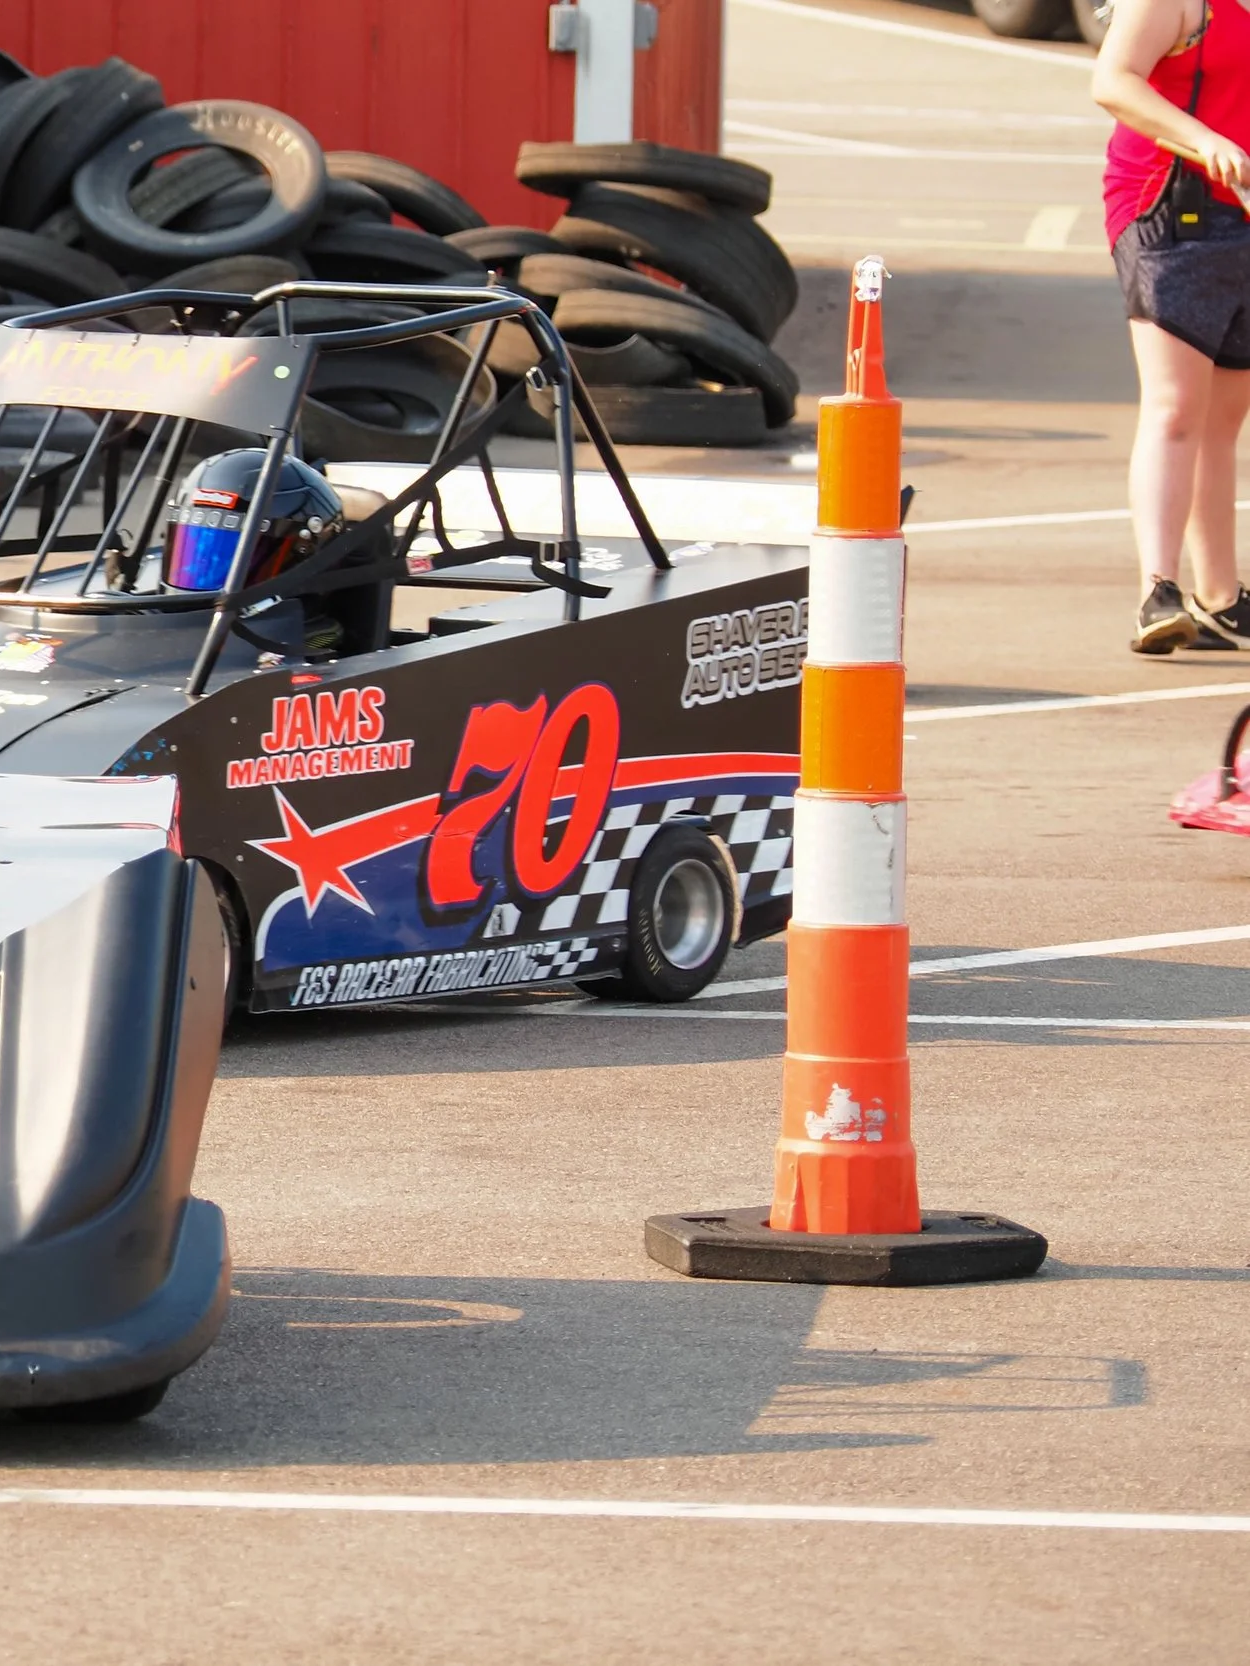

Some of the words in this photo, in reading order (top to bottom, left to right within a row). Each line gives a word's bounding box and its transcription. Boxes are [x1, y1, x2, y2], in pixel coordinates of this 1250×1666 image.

[687, 601, 799, 662] SHAVER
[681, 650, 757, 708] AUTO
[261, 686, 385, 753] JAMS
[227, 739, 414, 789] MANAGEMENT
[426, 682, 620, 905] 70
[330, 956, 428, 1003] RACECAR
